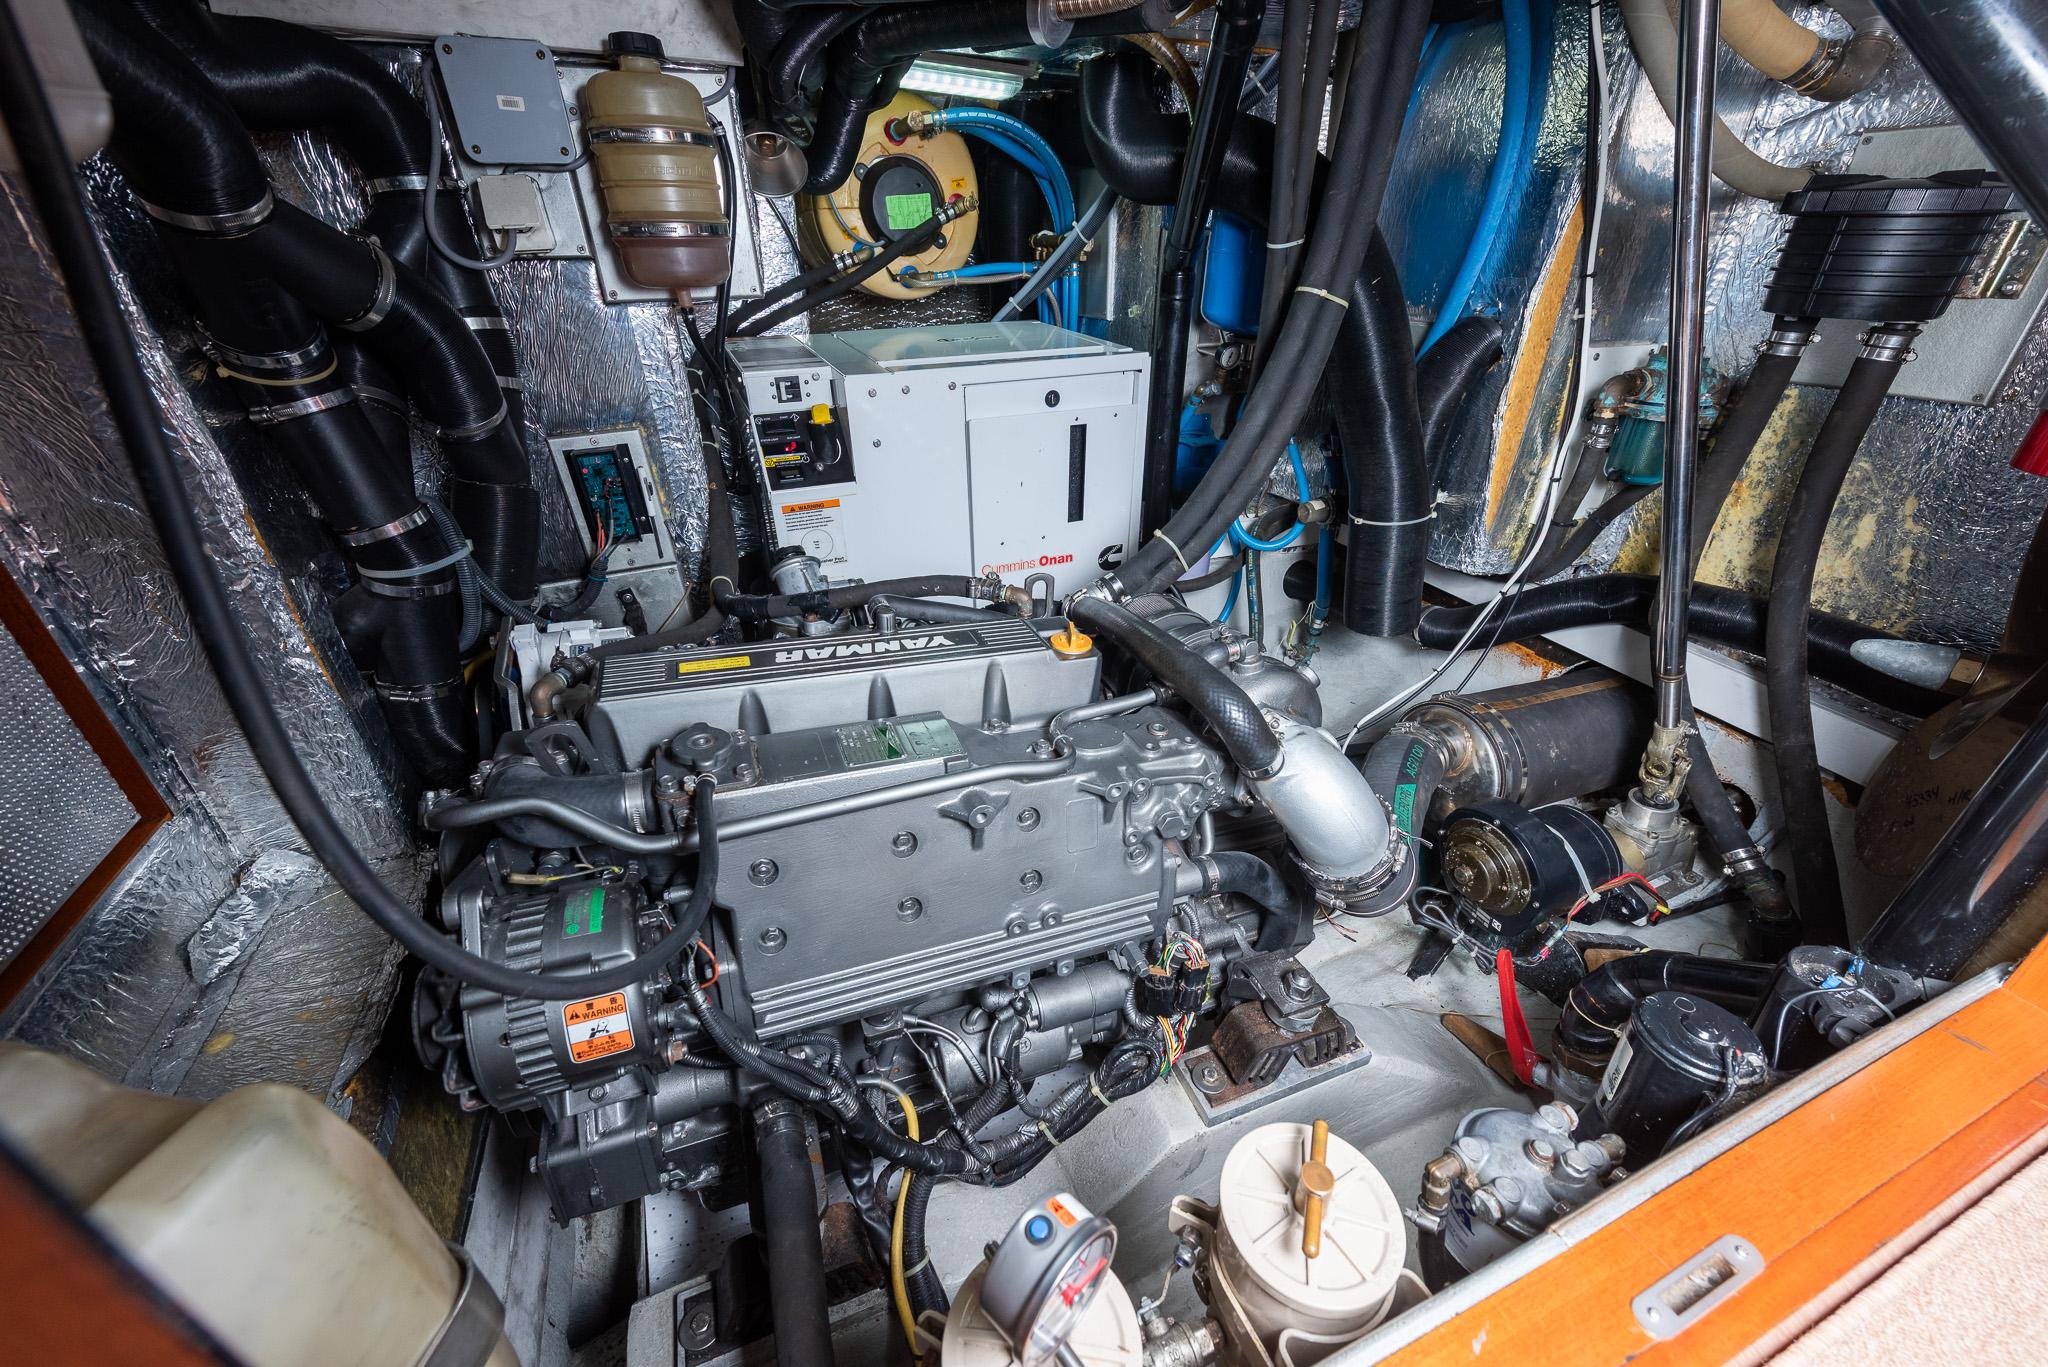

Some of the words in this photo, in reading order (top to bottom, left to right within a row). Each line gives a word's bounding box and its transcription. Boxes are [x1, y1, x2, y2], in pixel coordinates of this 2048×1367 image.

[798, 503, 825, 511] WARNING
[981, 559, 1036, 576] Cummins
[1039, 553, 1073, 567] Onan
[775, 635, 955, 664] YANMAR
[1406, 744, 1425, 778] AG2100
[582, 1004, 624, 1019] WARNING
